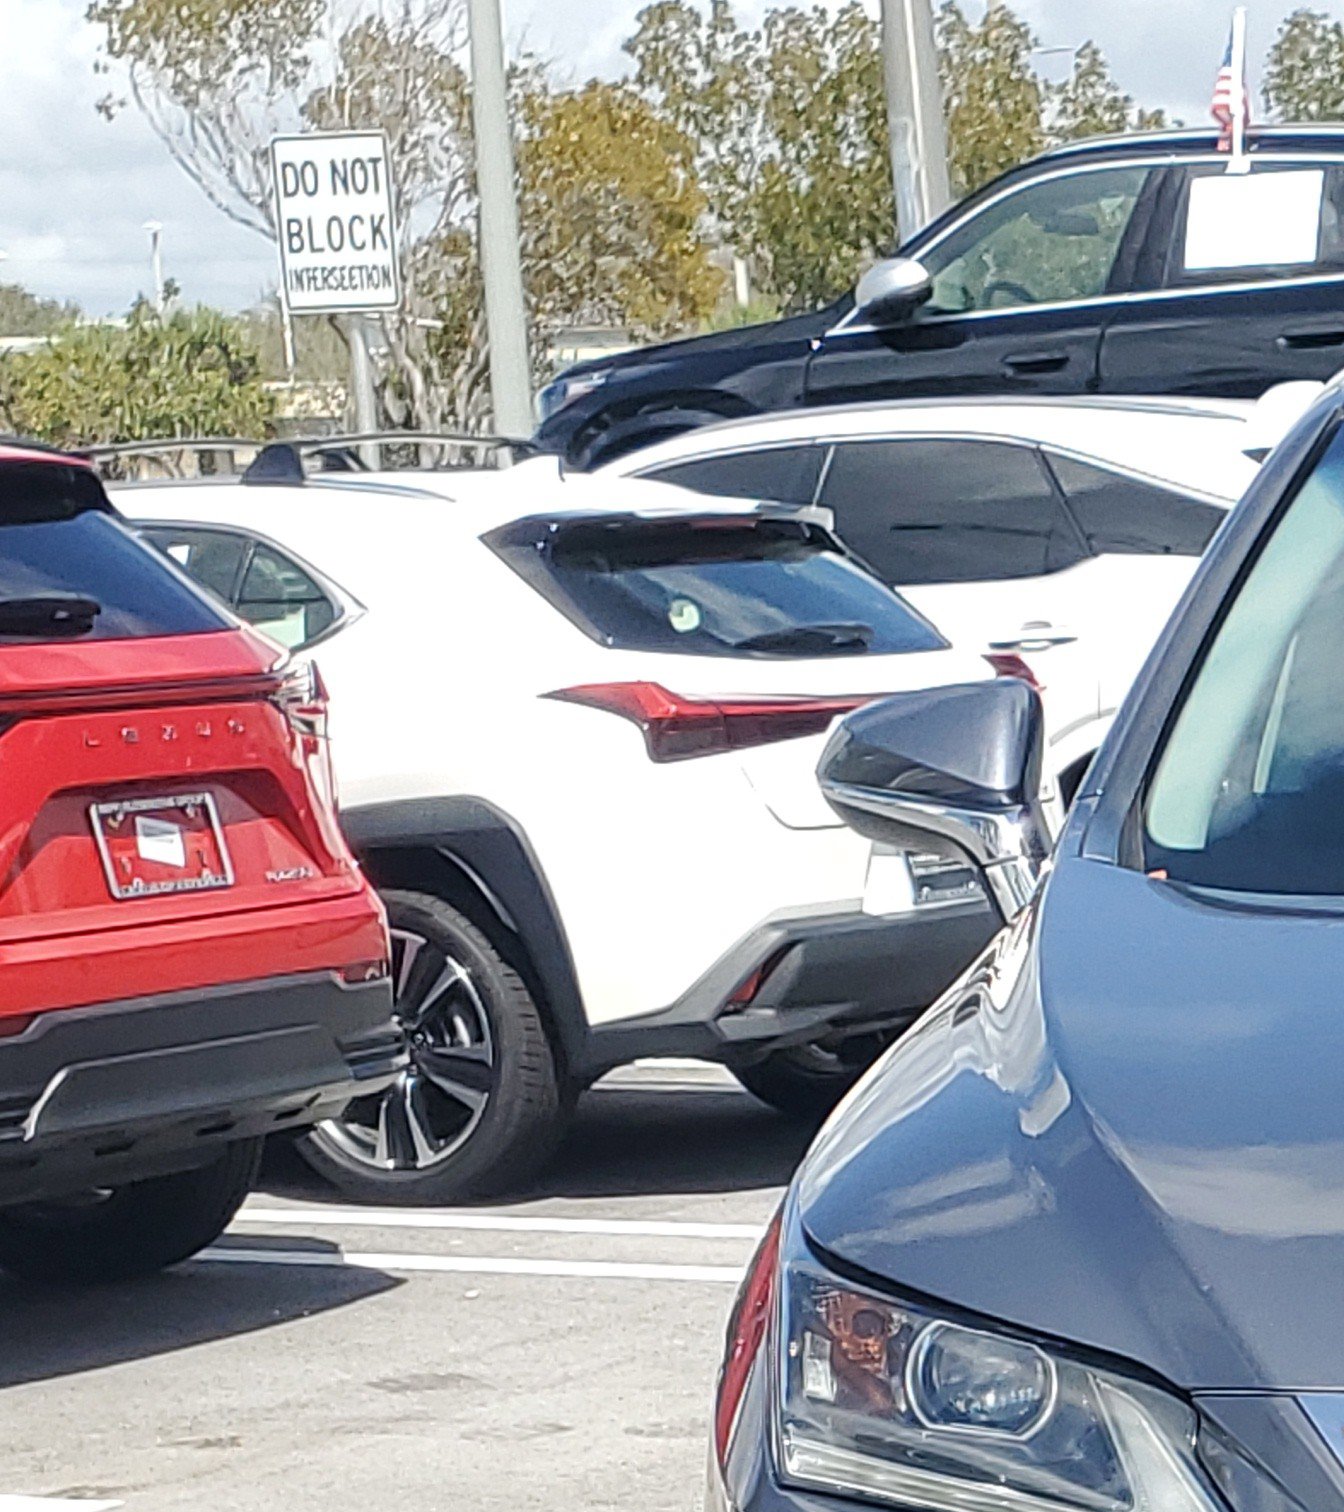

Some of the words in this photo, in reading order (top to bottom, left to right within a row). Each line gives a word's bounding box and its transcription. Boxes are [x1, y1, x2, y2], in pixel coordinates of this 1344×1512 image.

[281, 159, 318, 198] DO
[330, 157, 382, 196] NOT
[286, 213, 388, 254] BLOCK
[289, 264, 392, 292] INTERSECTION
